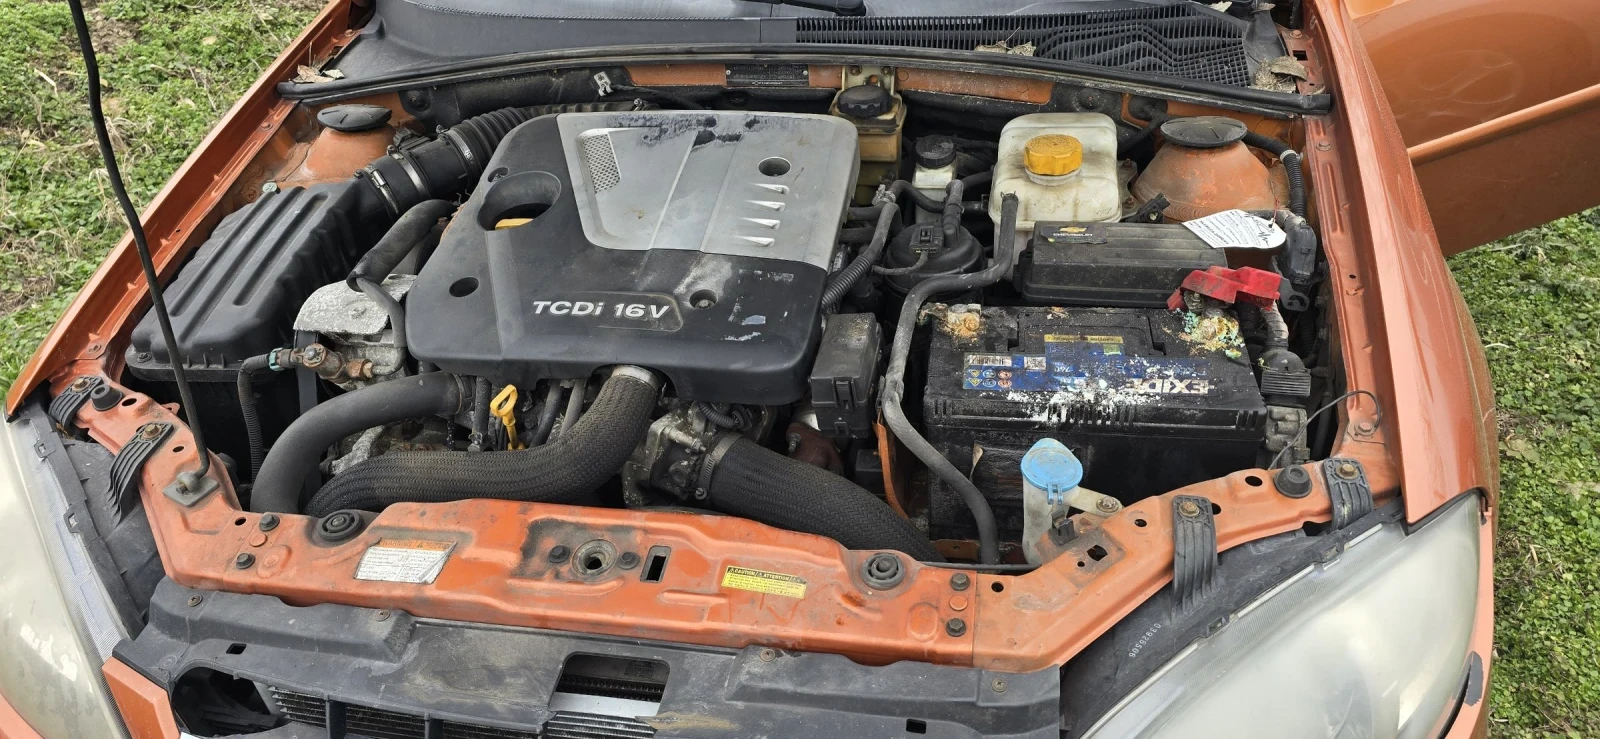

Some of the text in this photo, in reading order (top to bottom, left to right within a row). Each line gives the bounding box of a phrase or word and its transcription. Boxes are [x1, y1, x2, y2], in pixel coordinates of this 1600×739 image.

[533, 301, 669, 319] TCDi 16V
[734, 569, 756, 577] CAUTION
